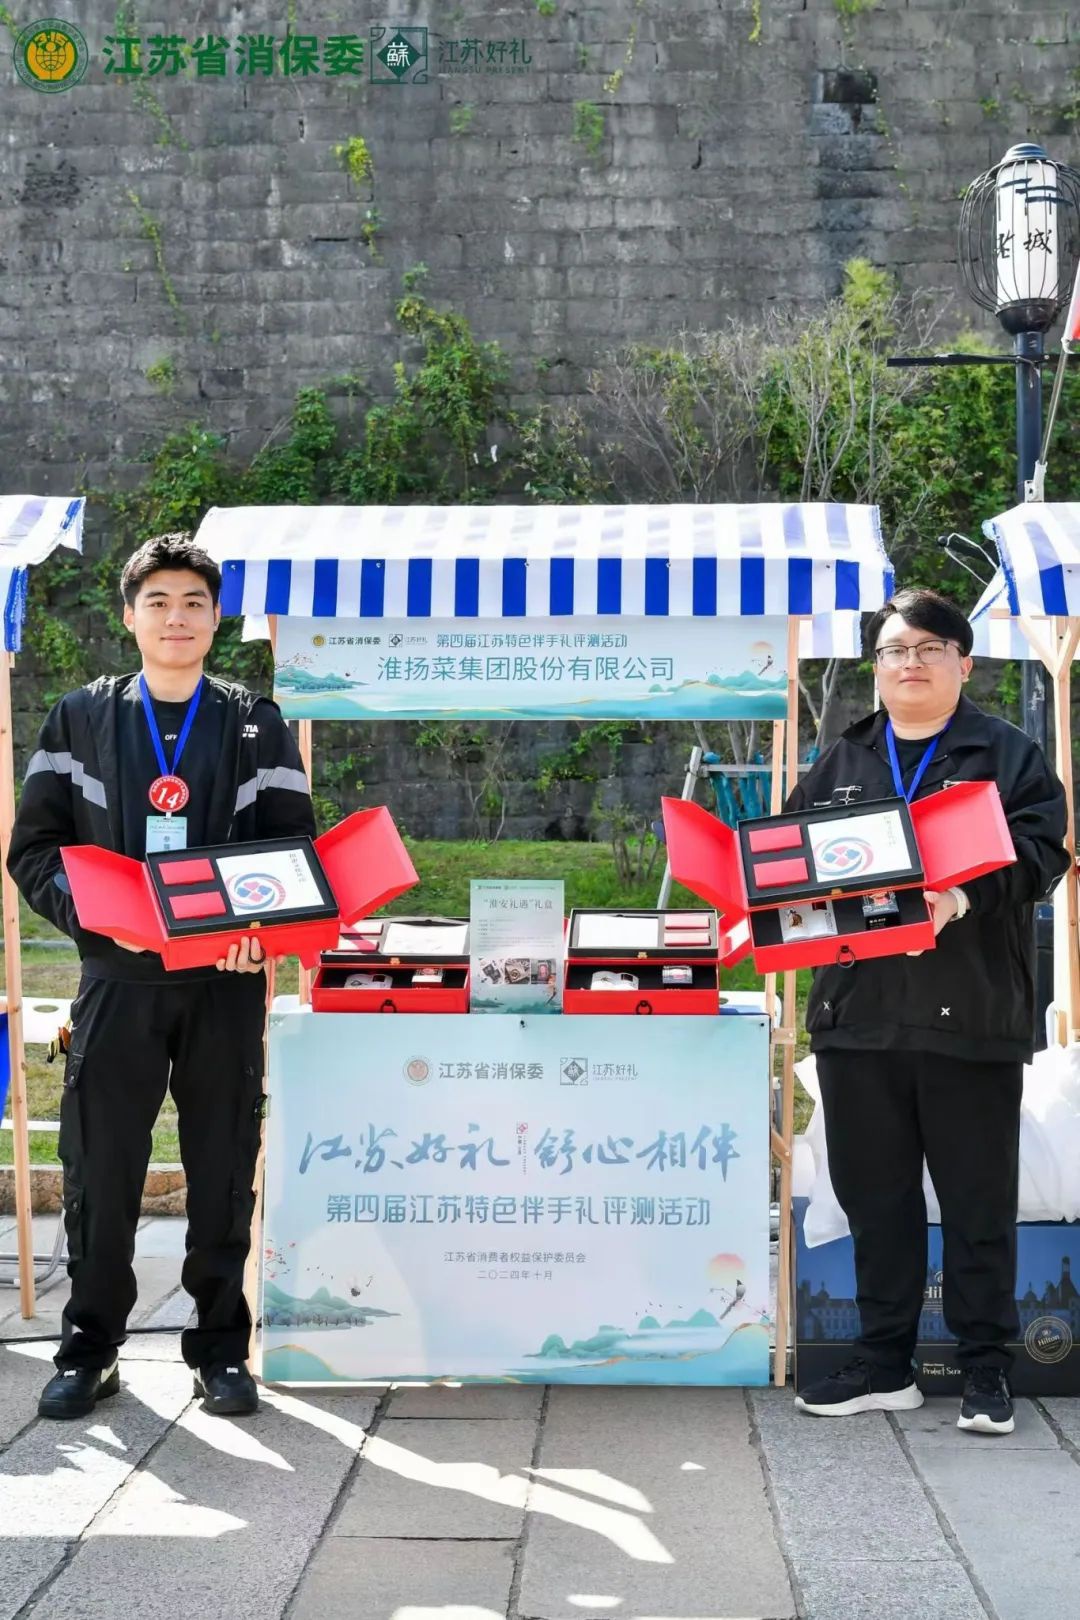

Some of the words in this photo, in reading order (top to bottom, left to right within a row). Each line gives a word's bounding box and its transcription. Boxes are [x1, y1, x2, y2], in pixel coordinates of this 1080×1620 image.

[328, 636, 381, 646] 江苏省消保委
[436, 633, 628, 649] 第四届江苏特色伴手礼评测活动
[377, 656, 675, 682] 淮扬菜集团股份有限公司
[156, 787, 180, 809] 14
[438, 1062, 544, 1081] 江苏省消保委
[592, 1063, 638, 1077] 江苏好礼
[298, 1122, 511, 1176] 江苏好礼
[533, 1122, 741, 1183] 舒心相伴
[326, 1194, 712, 1227] 第四届江苏特色伴手礼评测活动
[444, 1251, 587, 1264] 江苏省消费者权益保护委员会
